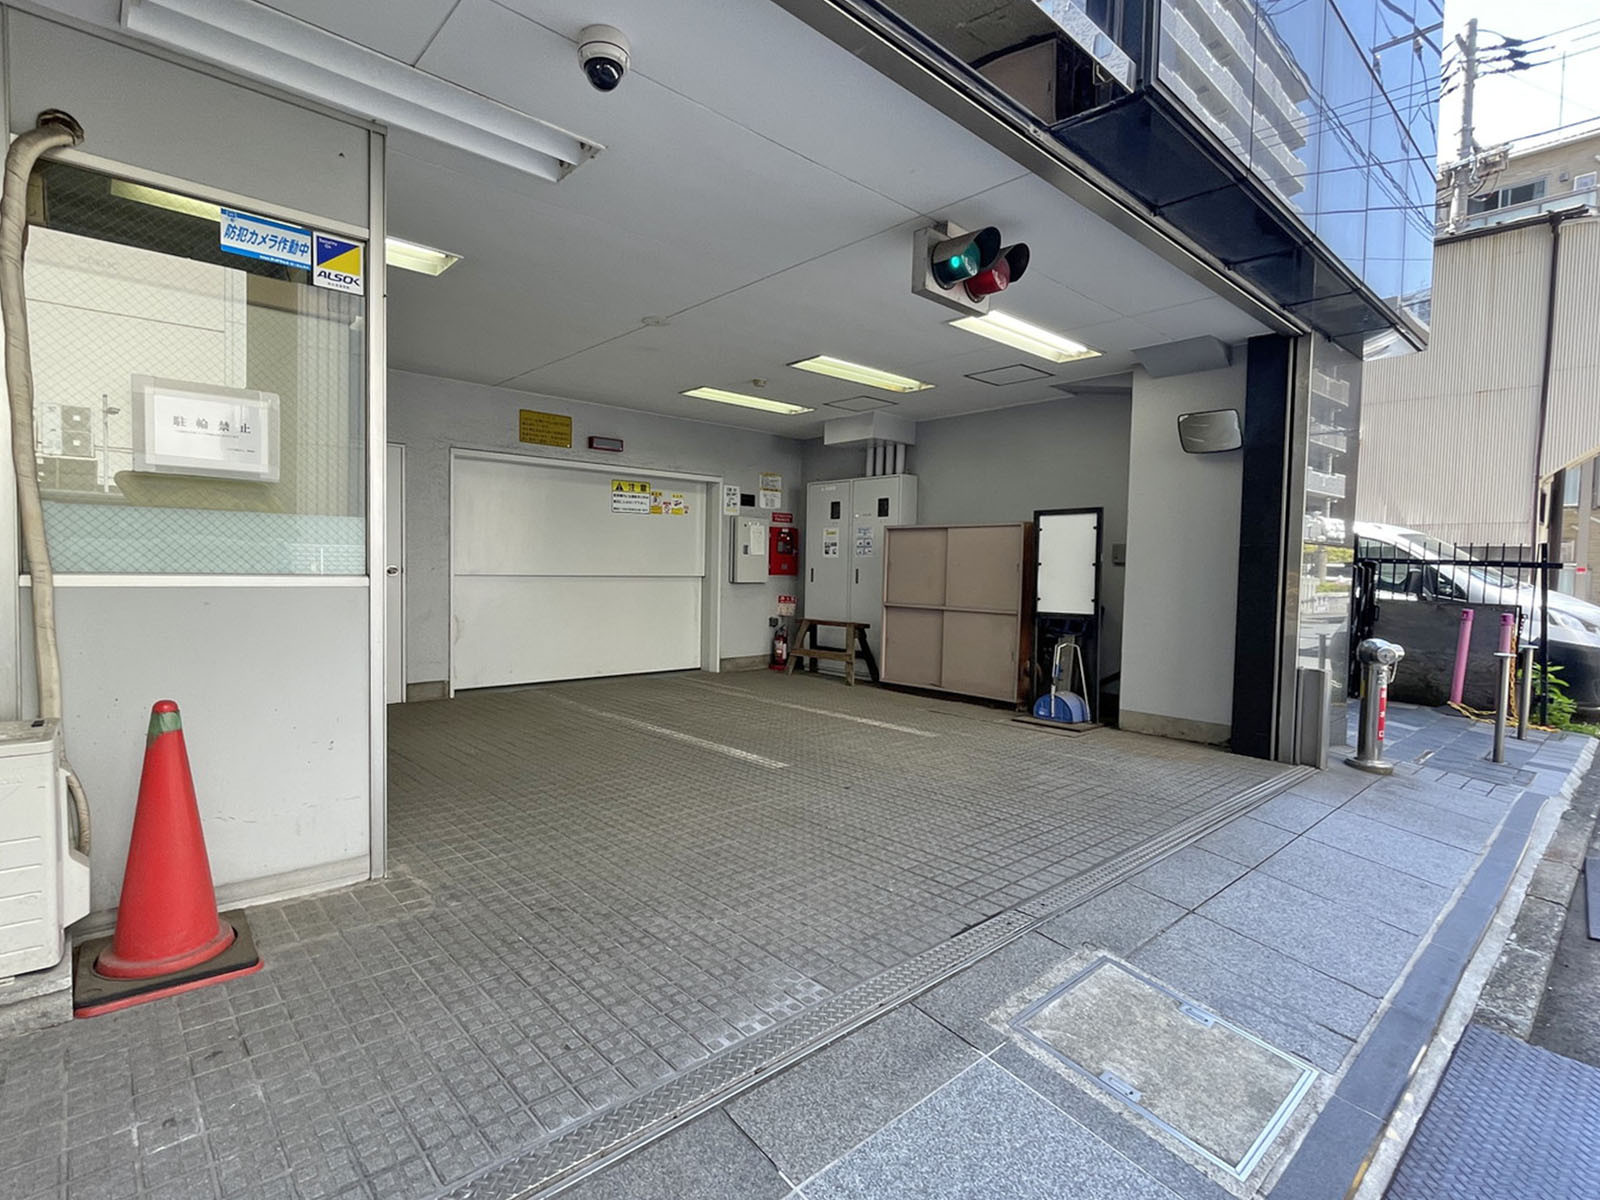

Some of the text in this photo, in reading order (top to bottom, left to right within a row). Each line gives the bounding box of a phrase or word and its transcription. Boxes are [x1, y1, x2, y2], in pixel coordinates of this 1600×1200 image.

[223, 223, 310, 257] 防犯カメラ作動中
[317, 269, 360, 287] ALSOK
[173, 415, 252, 435] 駐輪禁止
